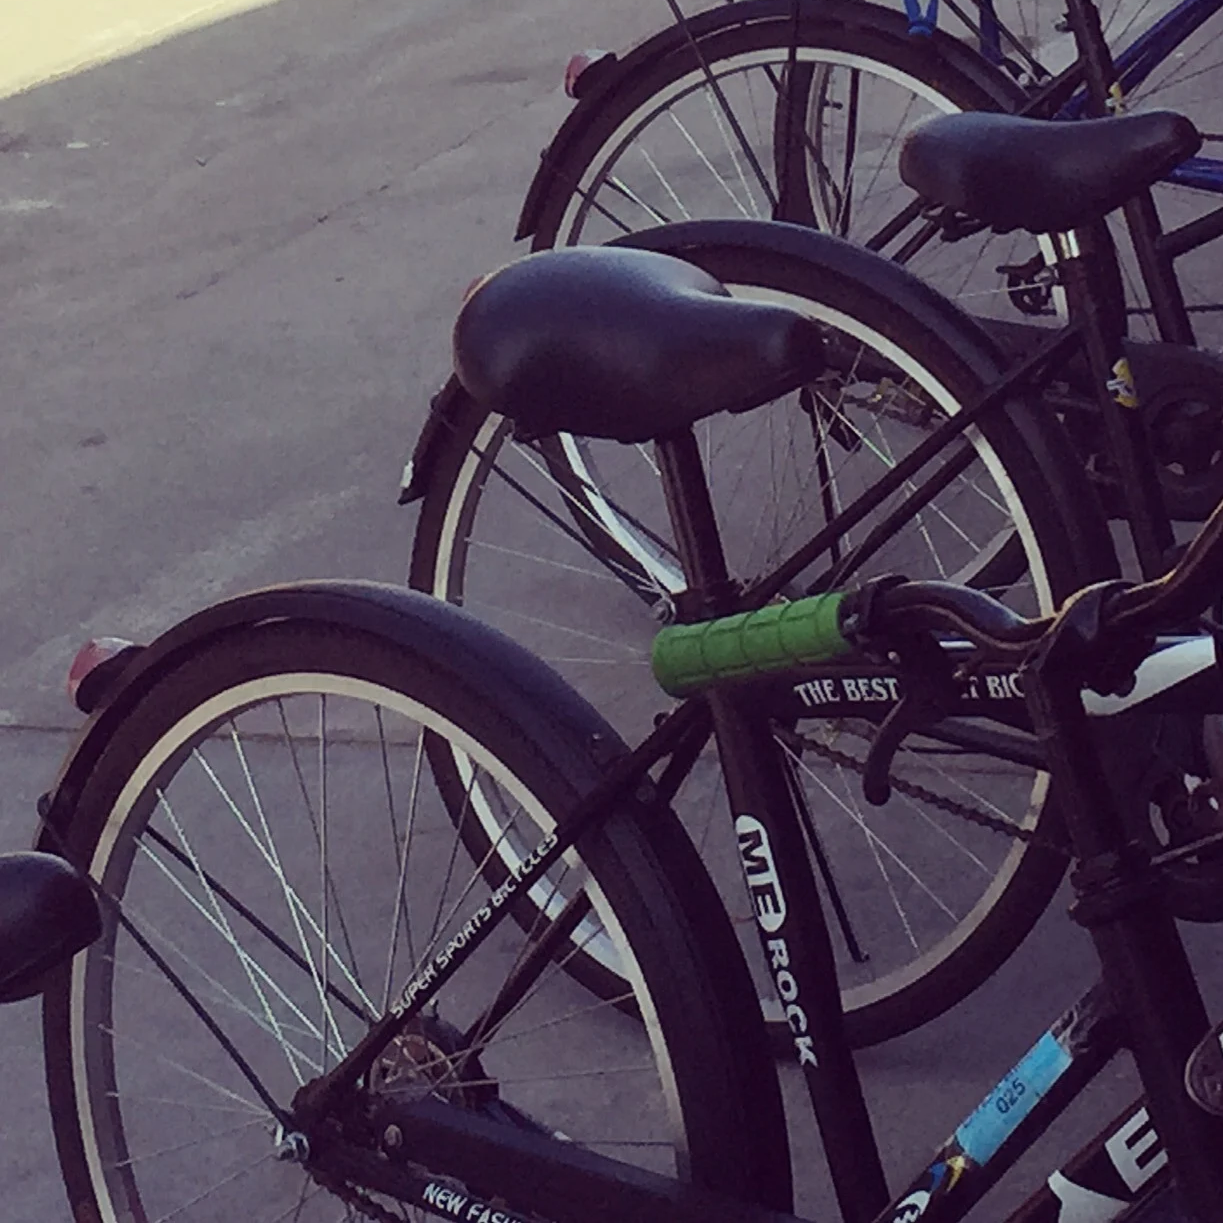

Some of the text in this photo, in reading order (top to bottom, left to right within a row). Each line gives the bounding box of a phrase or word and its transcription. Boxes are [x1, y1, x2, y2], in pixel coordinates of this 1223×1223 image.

[793, 679, 840, 707] THE
[843, 677, 899, 702] BEST
[390, 832, 559, 1019] SUPER SPORTS BICYCLES
[767, 938, 819, 1070] ROCK
[995, 1078, 1027, 1115] 025
[422, 1182, 468, 1216] NEW
